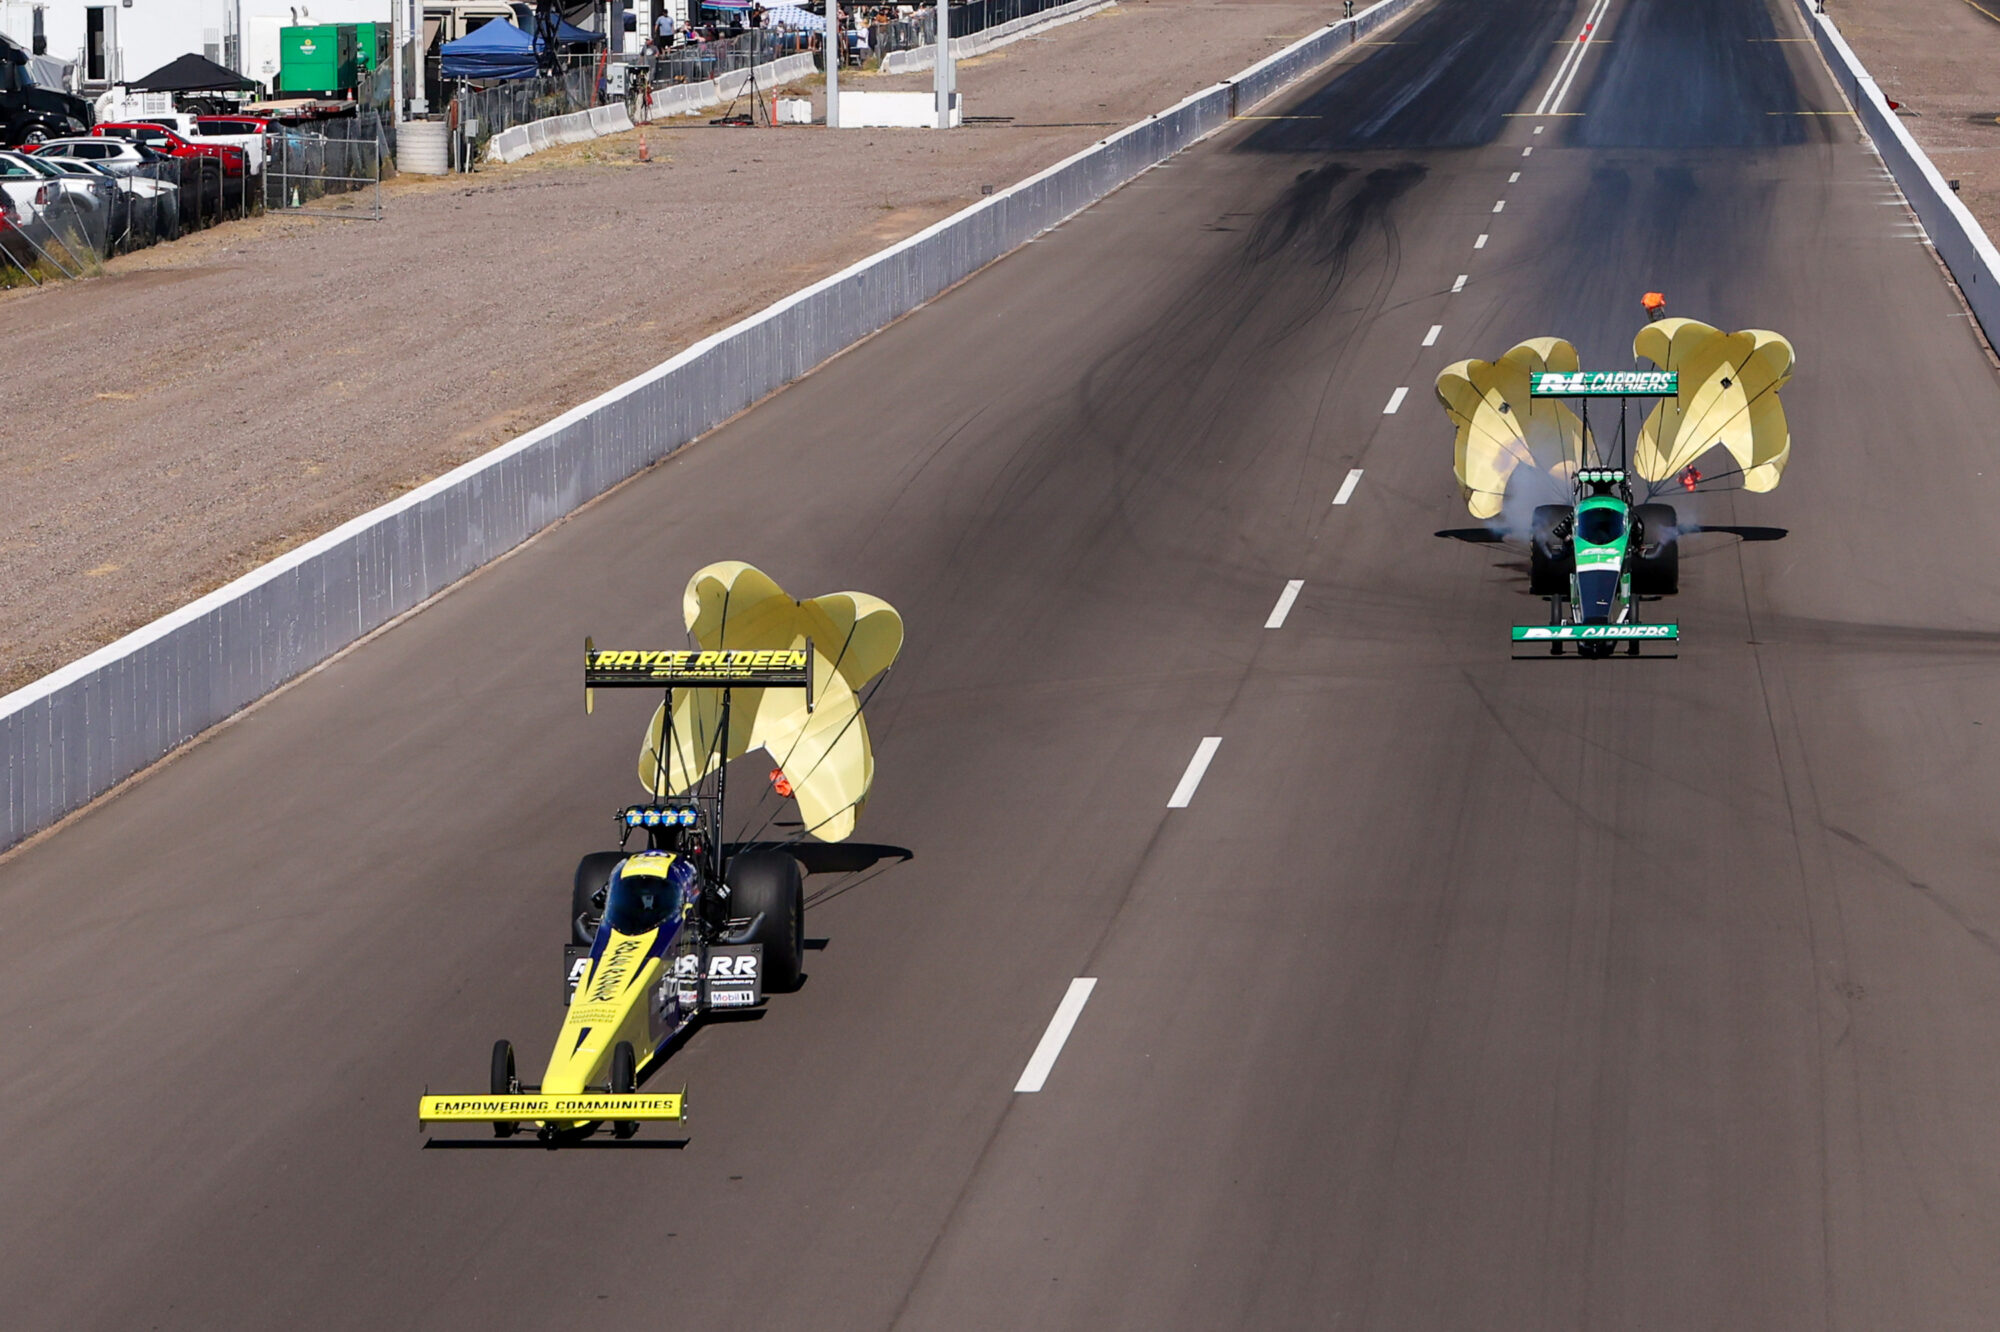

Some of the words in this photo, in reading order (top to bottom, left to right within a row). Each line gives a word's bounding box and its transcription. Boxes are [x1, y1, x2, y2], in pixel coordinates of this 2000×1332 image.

[1590, 372, 1672, 391] CARRIERS
[1581, 626, 1670, 638] CARRIERS
[594, 650, 693, 671] RAYCE
[694, 650, 807, 671] RUDEEN
[708, 955, 757, 975] RR
[713, 992, 740, 1001] Mobil
[435, 1101, 550, 1111] EMPOWERING
[555, 1100, 673, 1110] COMMUNITIES
